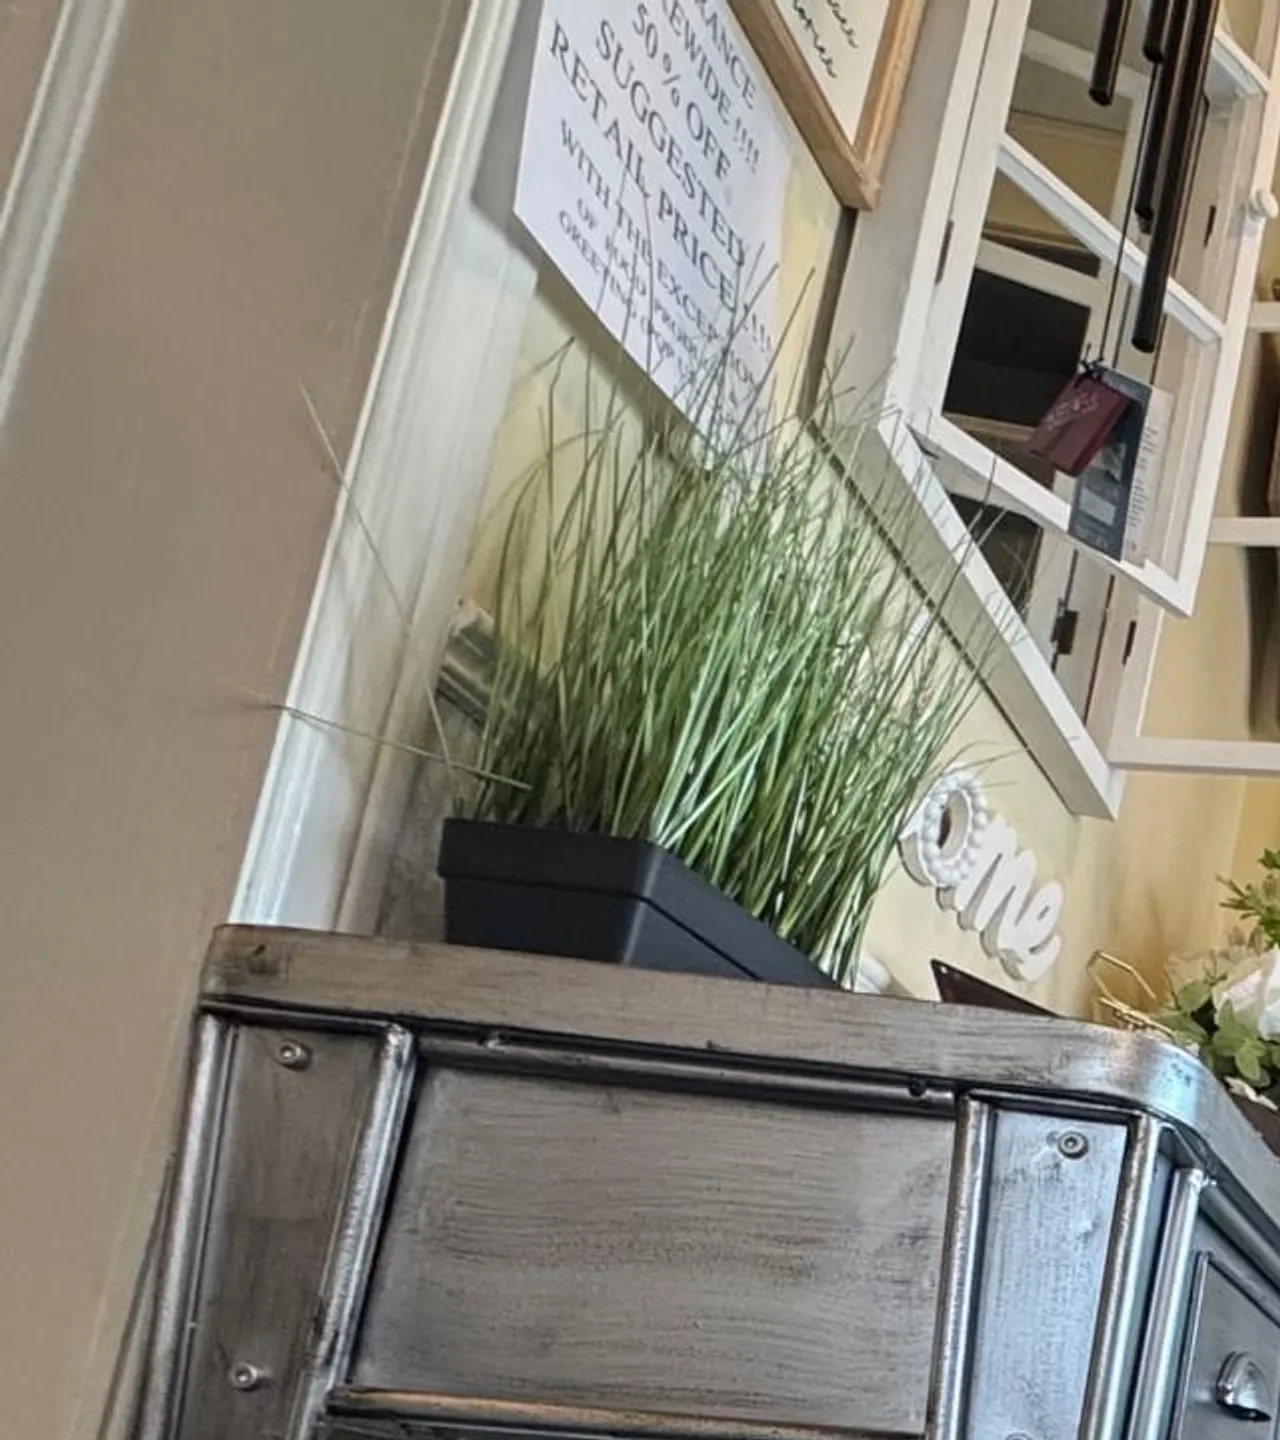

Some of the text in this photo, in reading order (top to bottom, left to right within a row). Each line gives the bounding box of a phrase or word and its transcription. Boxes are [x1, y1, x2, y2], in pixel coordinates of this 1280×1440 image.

[632, 3, 659, 60] 50
[686, 101, 732, 181] OFF
[662, 0, 731, 126] EWIDE
[695, 0, 756, 111] ANCE
[550, 18, 650, 199] RETAIL
[657, 188, 737, 313] PRICE
[561, 117, 611, 209] WITH
[595, 19, 745, 267] SUGGESTED
